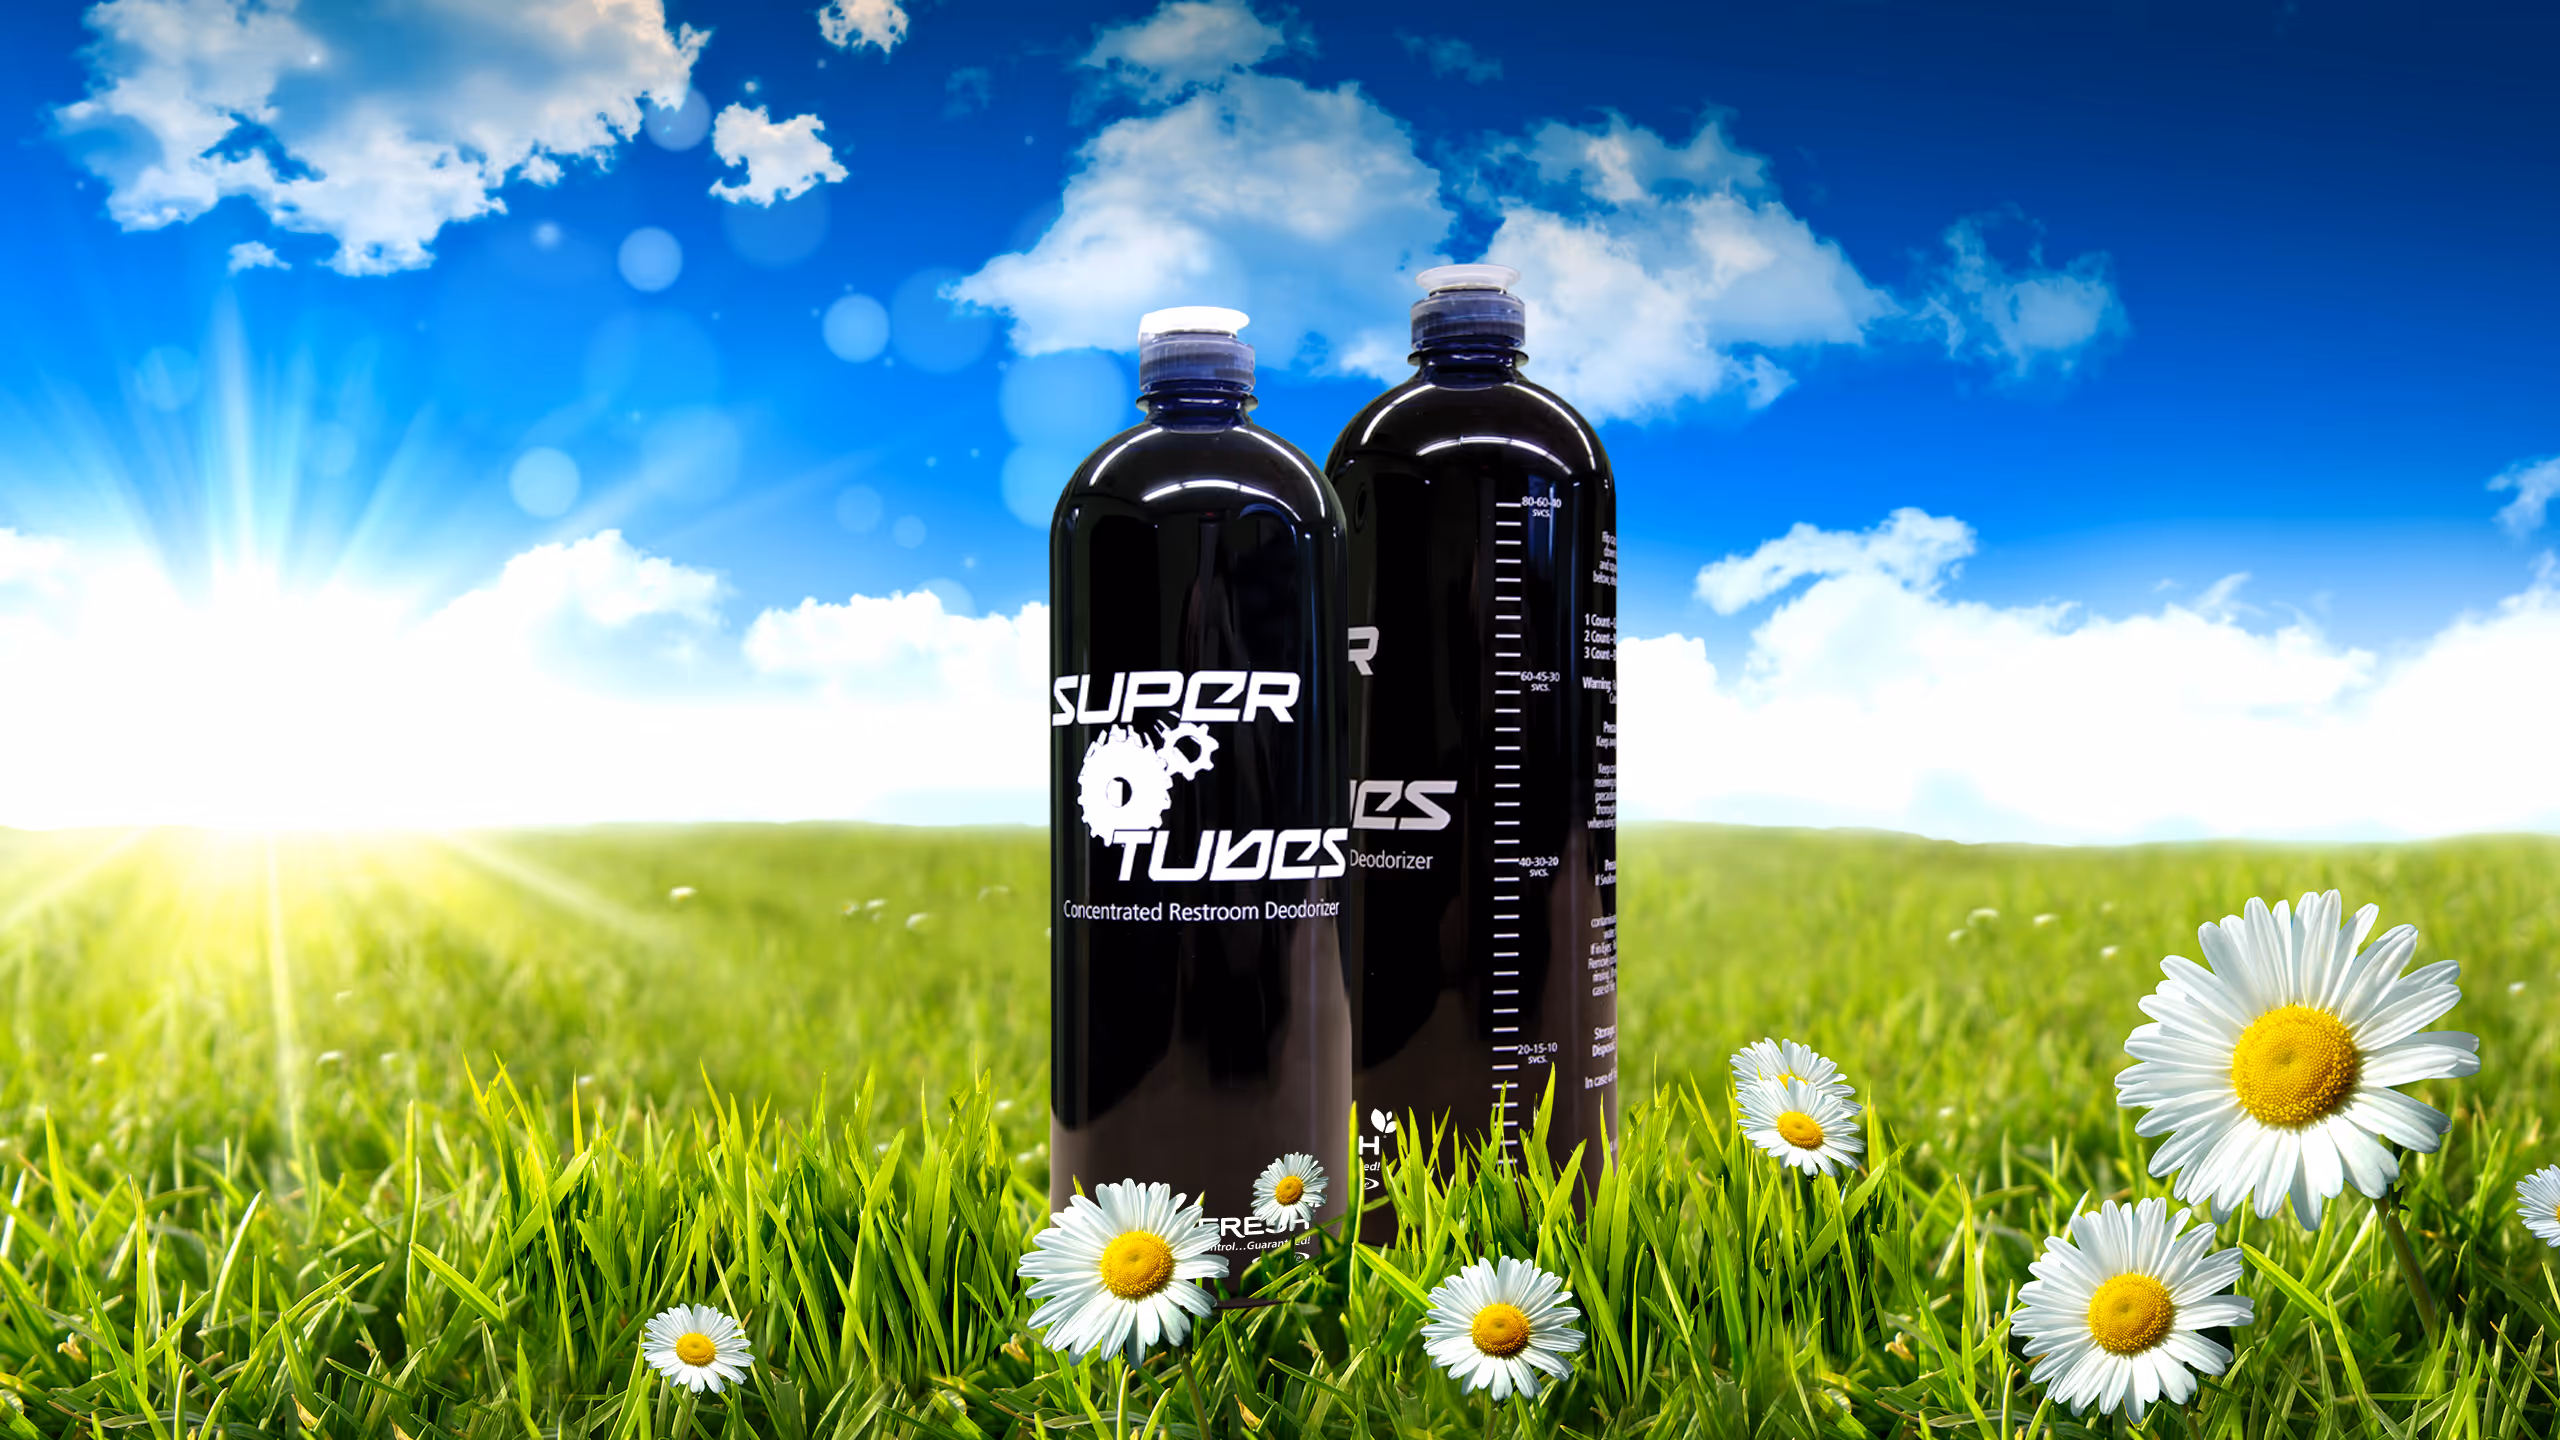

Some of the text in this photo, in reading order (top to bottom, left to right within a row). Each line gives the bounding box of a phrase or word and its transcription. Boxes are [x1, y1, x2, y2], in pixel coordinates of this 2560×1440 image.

[1584, 613, 1590, 626] 1
[1584, 629, 1590, 642] 2
[1584, 646, 1590, 659] 3
[1520, 671, 1561, 682] 60-45-30
[1052, 670, 1301, 727] SUPER
[1112, 828, 1349, 881] TUBES
[1350, 850, 1434, 870] Deodorizer
[1519, 856, 1559, 867] 40-30-20
[1063, 899, 1340, 921] Concentrated Restroom Deodorizer
[1517, 1042, 1558, 1056] 20-15-10
